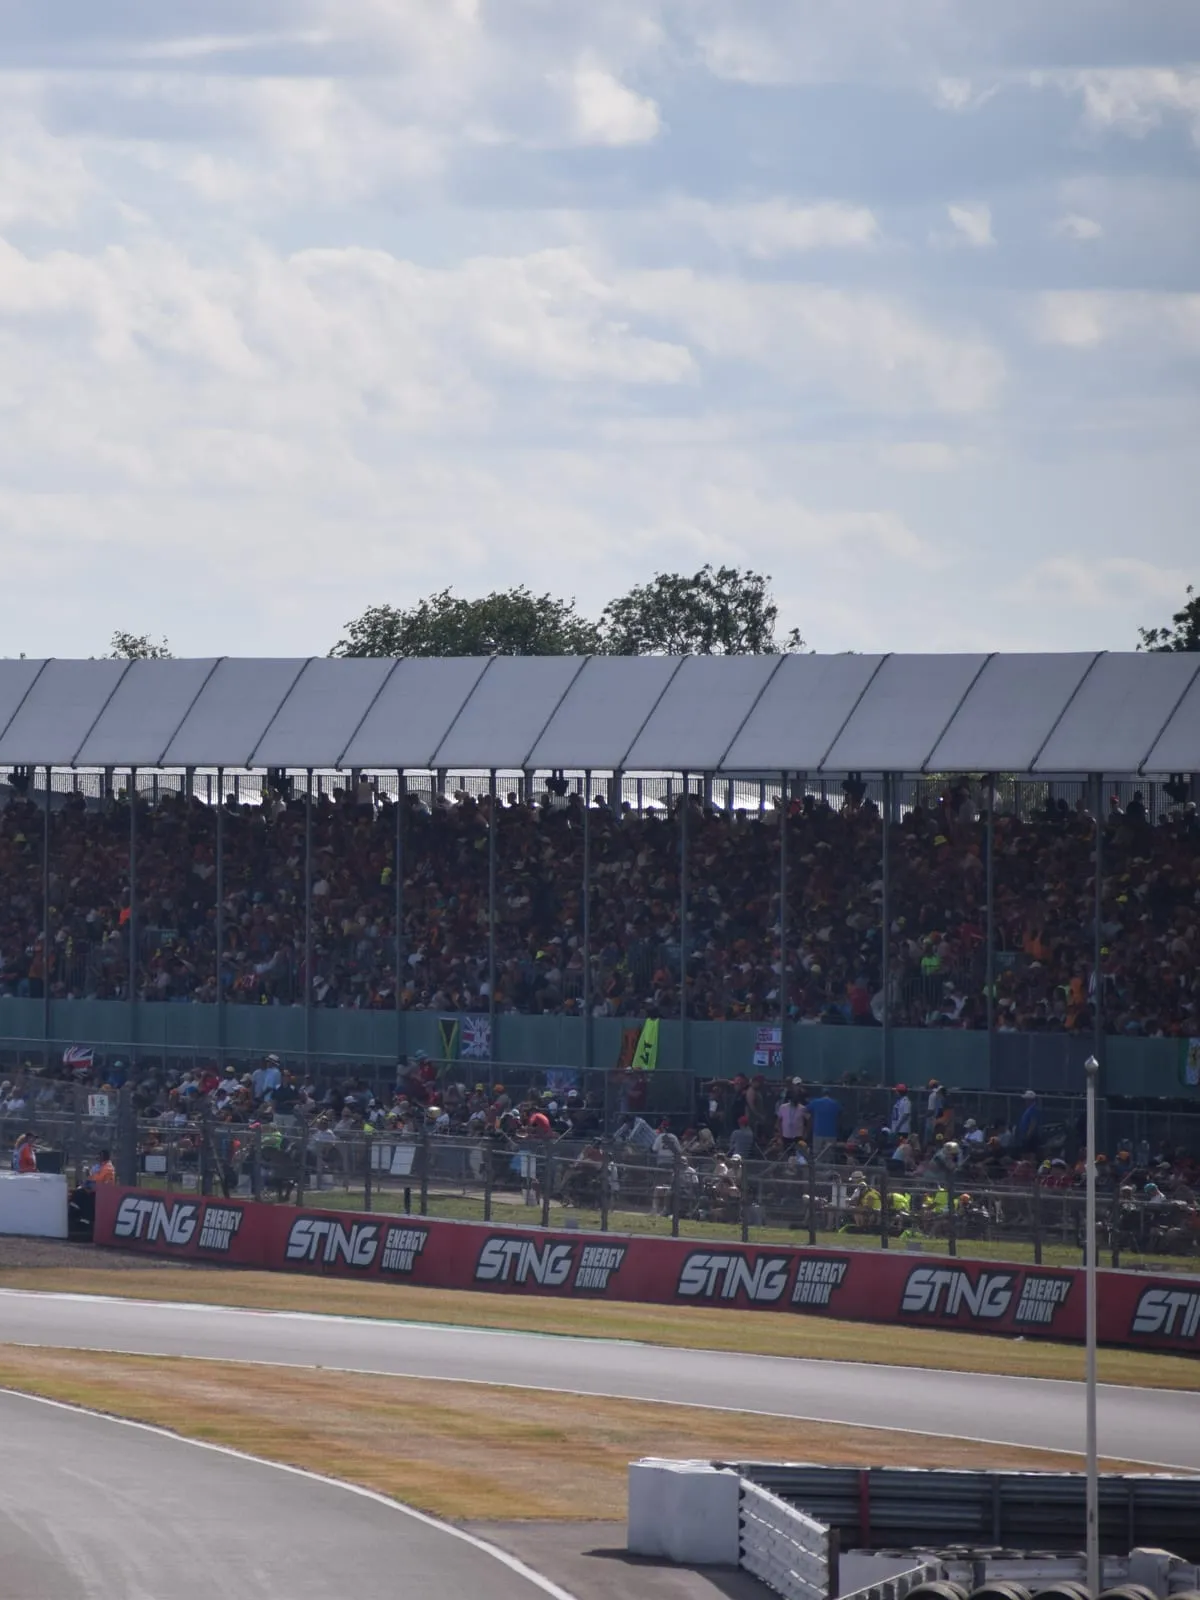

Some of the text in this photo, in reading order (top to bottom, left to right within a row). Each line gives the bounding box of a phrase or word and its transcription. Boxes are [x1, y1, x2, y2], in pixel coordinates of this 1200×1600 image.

[114, 1197, 197, 1244] STING
[203, 1207, 243, 1231] ENERGY
[199, 1227, 231, 1249] DRINK
[286, 1219, 378, 1266] STING
[386, 1228, 427, 1252] ENERGY
[381, 1249, 415, 1271] DRINK
[476, 1239, 573, 1285] STING
[581, 1247, 625, 1269] ENERGY
[574, 1267, 610, 1289] DRINK
[678, 1254, 788, 1300] STING
[797, 1261, 848, 1284] ENERGY
[791, 1282, 832, 1304] DRINK
[902, 1269, 1013, 1317] STING
[1021, 1277, 1071, 1302] ENERGY
[1015, 1299, 1055, 1322] DRINK
